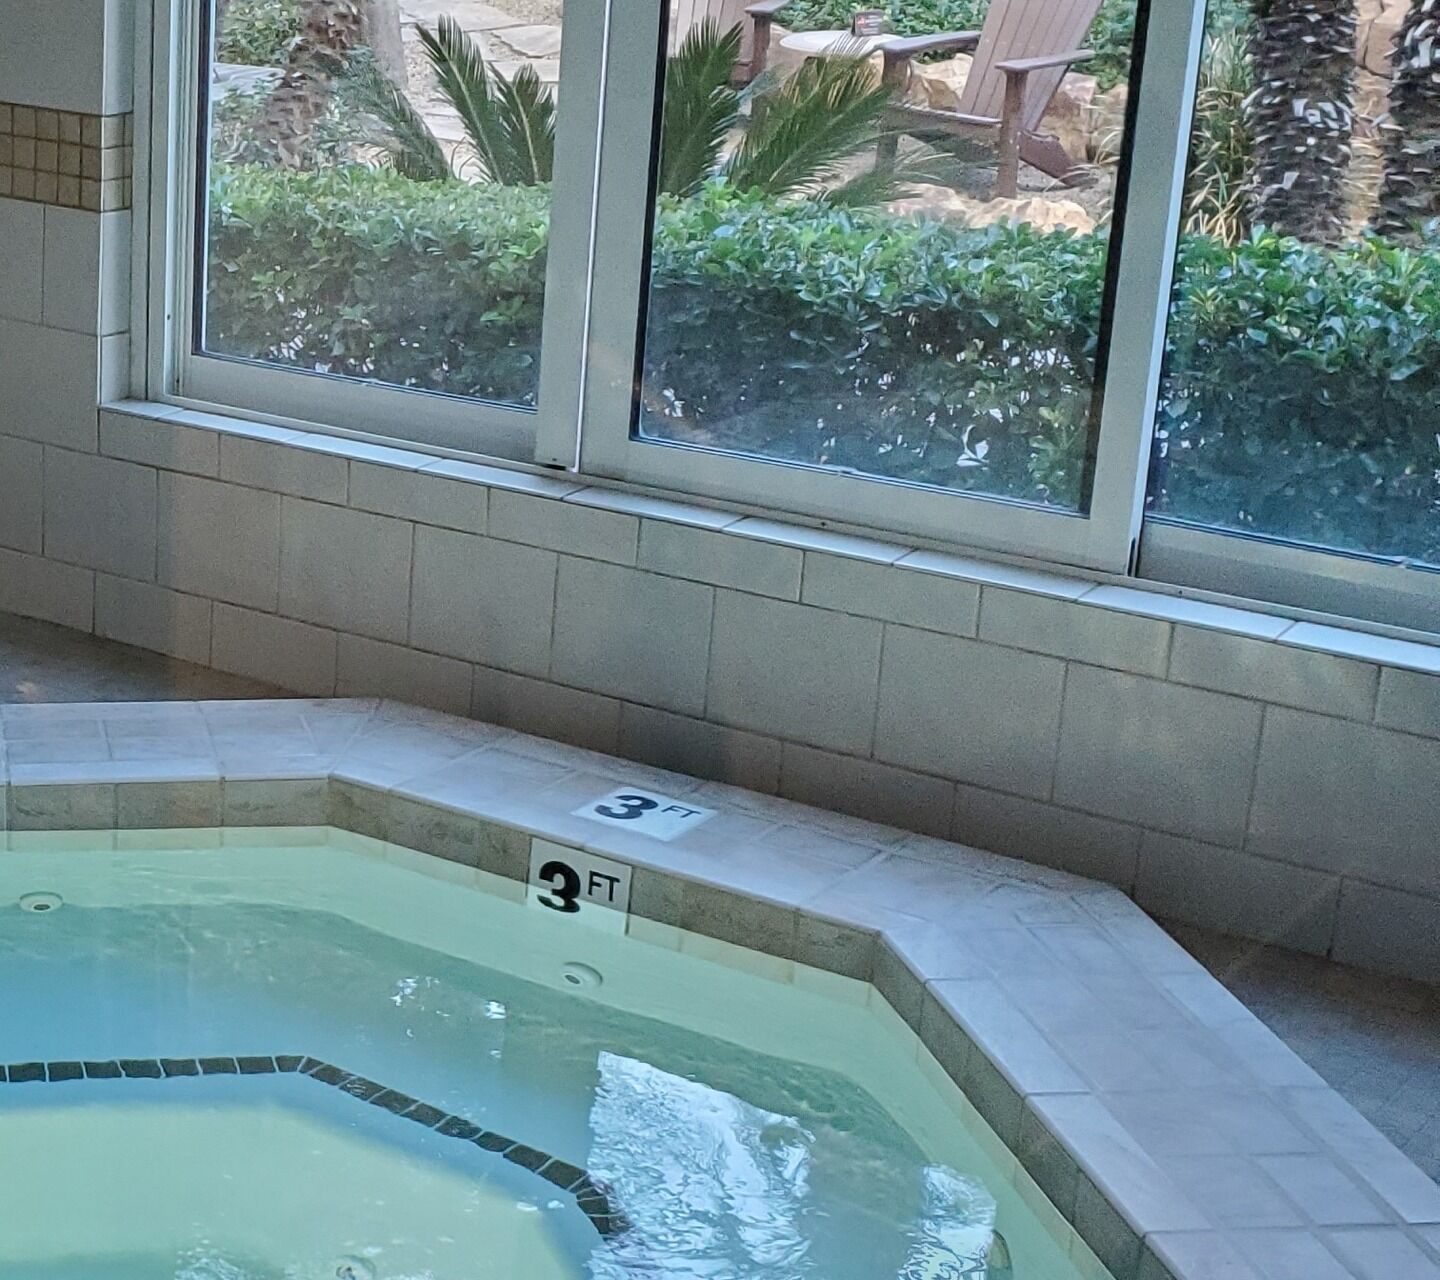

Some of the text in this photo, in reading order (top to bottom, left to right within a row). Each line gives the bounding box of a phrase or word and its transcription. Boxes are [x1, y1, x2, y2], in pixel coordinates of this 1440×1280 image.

[594, 794, 702, 820] 3 FT
[537, 860, 620, 913] 3 FT
